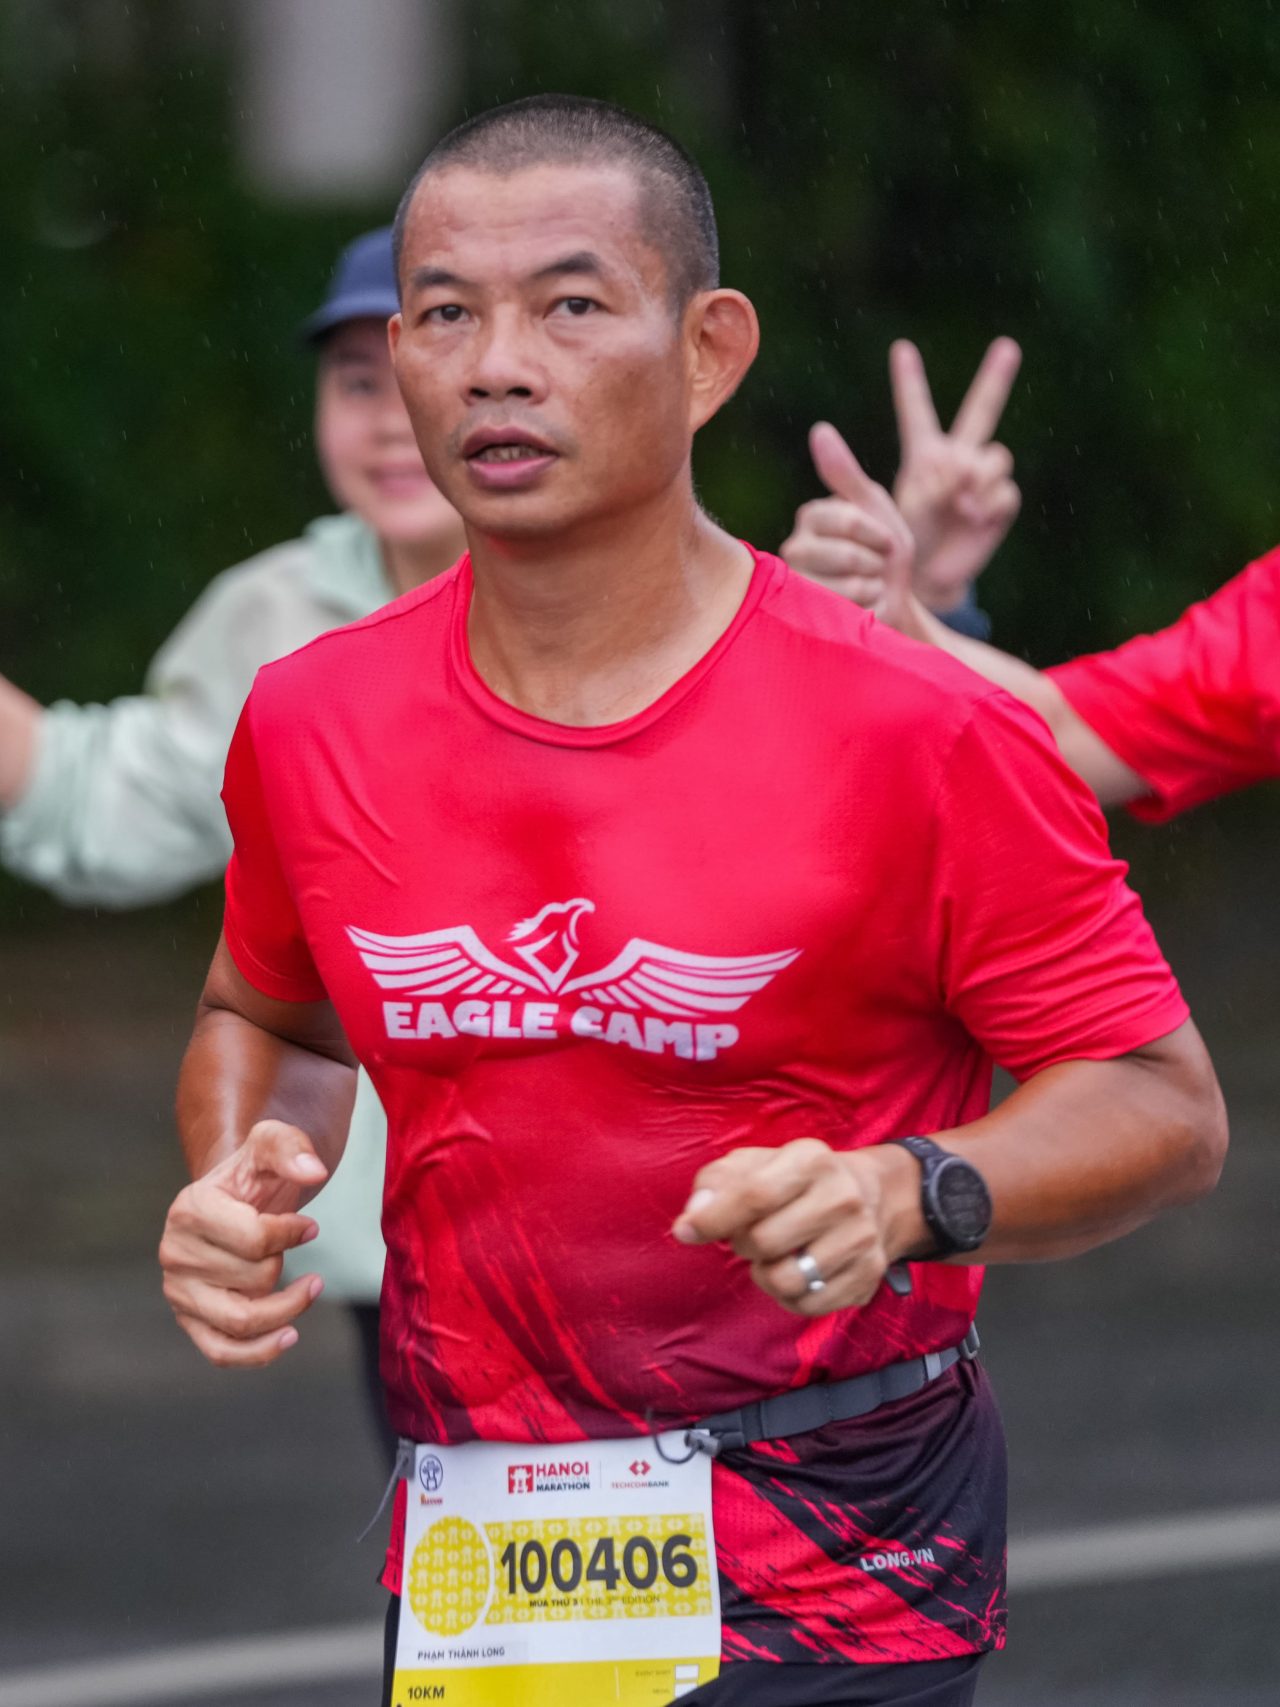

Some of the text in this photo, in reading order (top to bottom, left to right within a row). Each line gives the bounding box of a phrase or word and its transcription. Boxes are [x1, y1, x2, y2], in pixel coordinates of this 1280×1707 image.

[382, 1000, 739, 1061] EAGLE CAMP
[536, 1461, 590, 1477] HANOI
[536, 1482, 591, 1493] MARATHON
[611, 1480, 670, 1489] TECHCOMBANK
[501, 1534, 699, 1594] 100406
[860, 1547, 935, 1572] LONG.VN
[482, 1646, 505, 1659] LONG
[407, 1685, 446, 1700] 10KM
